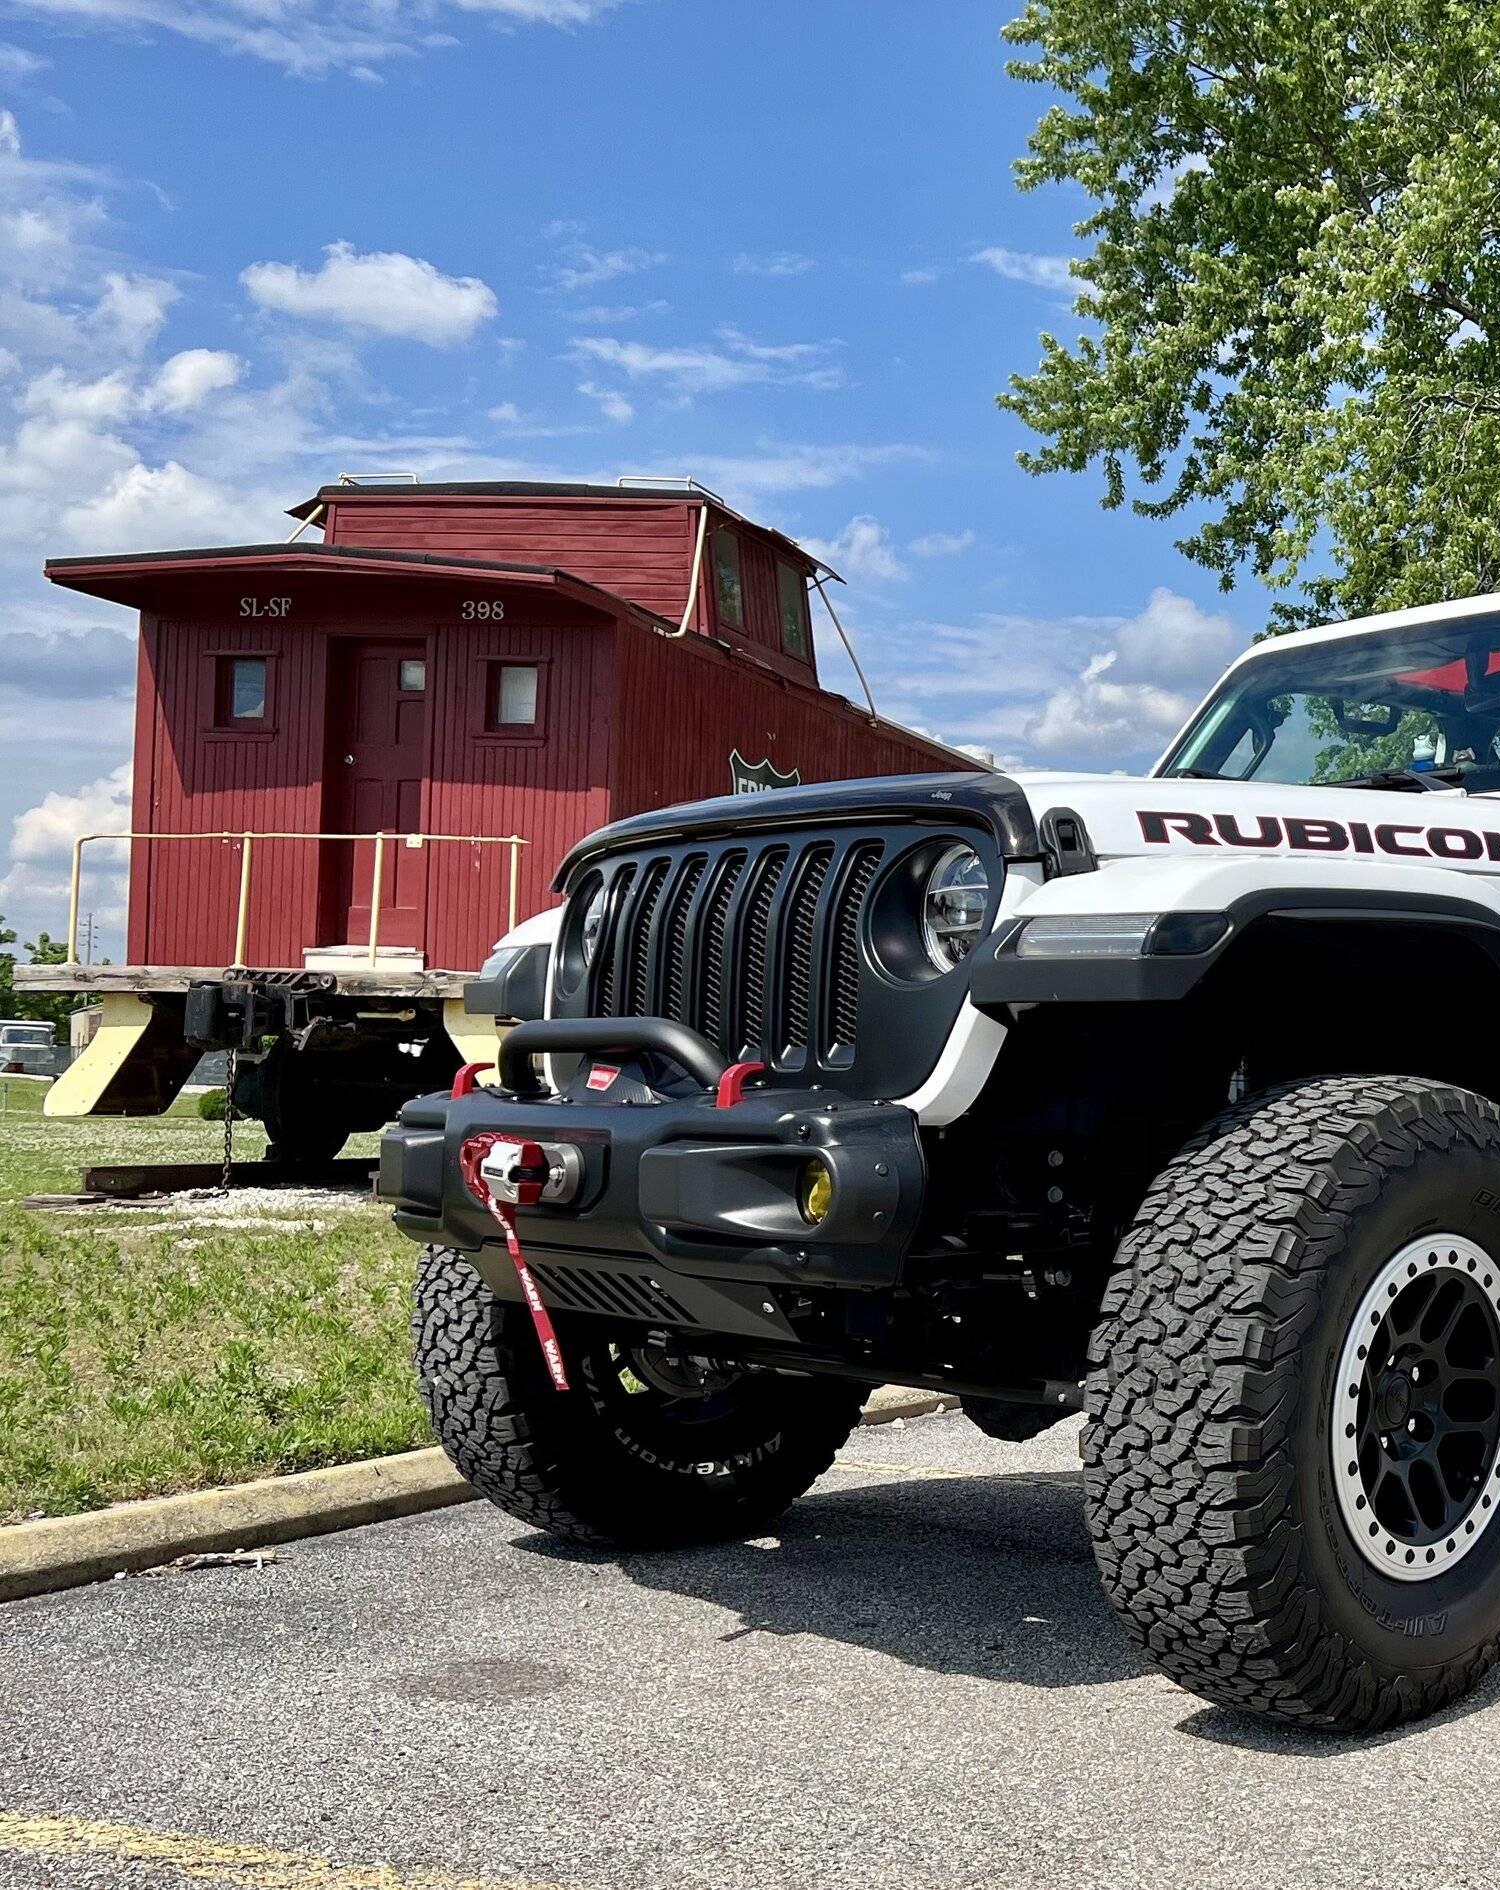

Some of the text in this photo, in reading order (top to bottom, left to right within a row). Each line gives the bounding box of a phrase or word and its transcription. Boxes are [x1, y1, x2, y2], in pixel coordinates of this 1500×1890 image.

[239, 597, 292, 617] SL-SF
[461, 600, 505, 620] 398
[519, 1266, 544, 1313] WARN
[543, 1337, 567, 1386] WARN
